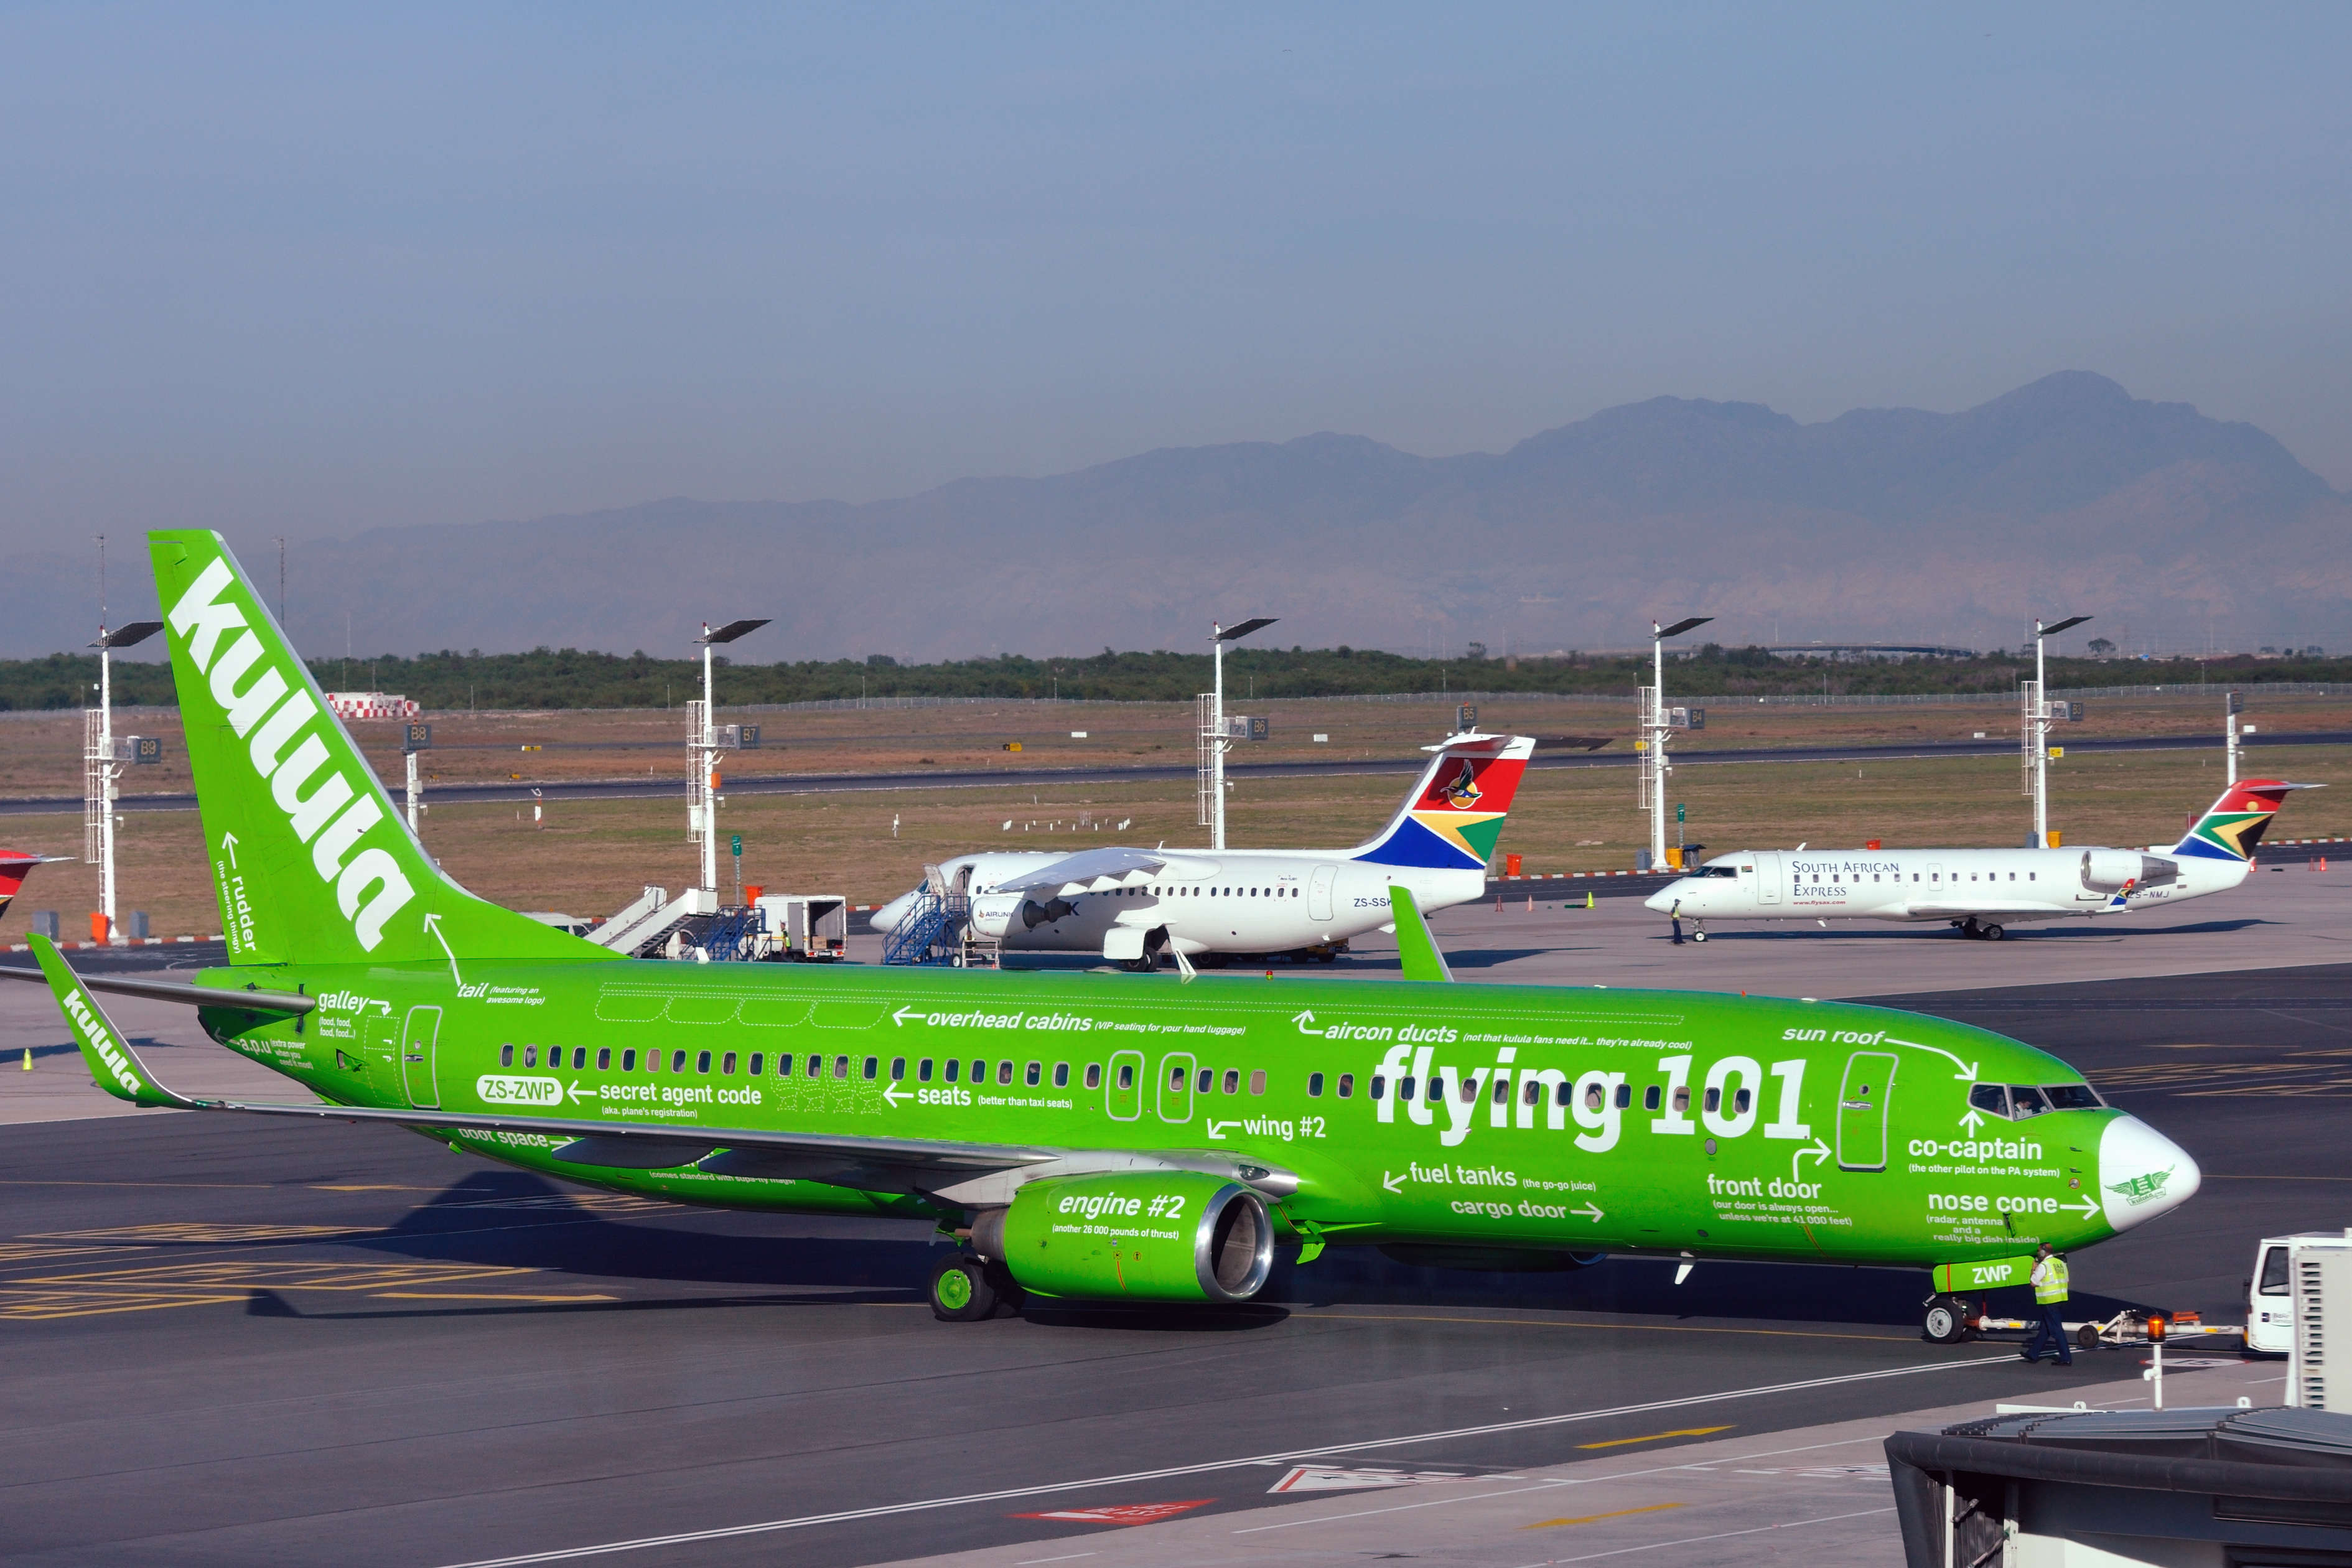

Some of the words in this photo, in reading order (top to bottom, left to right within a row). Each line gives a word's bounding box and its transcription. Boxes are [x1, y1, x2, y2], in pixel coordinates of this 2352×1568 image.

[411, 727, 426, 740] B8
[744, 728, 756, 741] B7
[1254, 720, 1265, 732] B6
[141, 740, 156, 755] B9
[167, 554, 417, 953] kulula
[1792, 861, 1837, 873] SOUTH
[1843, 861, 1900, 873] AFRICAN
[1794, 884, 1847, 897] EXPRESS
[217, 861, 225, 879] (the
[222, 881, 233, 920] steering
[230, 920, 243, 953] thingy)
[231, 876, 256, 953] rudder
[456, 981, 489, 997] tail
[490, 986, 528, 995] (featuring
[319, 991, 370, 1015] galley
[525, 996, 545, 1006] logo)
[319, 1017, 335, 1027] (food,
[337, 1018, 352, 1028] food,
[927, 1010, 1024, 1029] overhead
[1025, 1012, 1093, 1031] cabins
[1094, 1021, 1114, 1030] (VIP
[1114, 1023, 1146, 1033] seating
[1161, 1025, 1183, 1034] your
[1183, 1025, 1206, 1033] hand
[1207, 1025, 1246, 1035] luggage)
[62, 987, 142, 1096] kulula
[320, 1028, 335, 1038] food,
[1325, 1022, 1393, 1040] aircon
[1398, 1024, 1458, 1043] ducts
[1463, 1033, 1482, 1042] (not
[1483, 1034, 1501, 1042] that
[1503, 1034, 1532, 1043] kulula
[1533, 1035, 1553, 1043] fans
[1555, 1037, 1579, 1045] need
[1580, 1037, 1593, 1045] it...
[1597, 1037, 1630, 1047] they're
[1630, 1038, 1667, 1049] already
[1668, 1041, 1692, 1050] cool)
[1782, 1029, 1827, 1041] sun
[1832, 1031, 1885, 1045] roof
[239, 1038, 272, 1056] a.p.u
[483, 1080, 556, 1101] ZS-ZWP
[600, 1083, 657, 1101] secret
[662, 1085, 713, 1106] agent
[718, 1085, 762, 1105] code
[918, 1086, 971, 1106] seats
[978, 1095, 1006, 1106] (better
[1008, 1096, 1027, 1106] than
[1029, 1098, 1044, 1107] taxi
[1047, 1099, 1072, 1110] seats)
[1374, 1045, 1625, 1153] flying
[1650, 1055, 1811, 1140] 101
[602, 1106, 620, 1115] (aka.
[622, 1107, 650, 1116] plane's
[651, 1108, 697, 1119] registration)
[1244, 1119, 1293, 1141] wing
[1299, 1116, 1326, 1137] #2
[497, 1132, 548, 1147] space
[1909, 1137, 2042, 1164] co-captain
[1409, 1162, 1452, 1183] fuel
[1456, 1165, 1517, 1187] tanks
[1523, 1179, 1540, 1188] (the
[1542, 1182, 1569, 1191] go-go
[1570, 1181, 1596, 1192] juice)
[1909, 1164, 1925, 1173] (the
[1928, 1164, 1953, 1174] other
[1954, 1165, 1976, 1175] pilot
[1991, 1166, 2006, 1175] the
[2008, 1167, 2021, 1175] PA
[2023, 1168, 2060, 1178] system)
[1707, 1174, 1763, 1197] front
[1768, 1175, 1822, 1198] door
[1059, 1192, 1141, 1220] engine
[1147, 1195, 1185, 1218] #2
[1451, 1202, 1513, 1218] cargo
[1521, 1200, 1566, 1218] door
[1713, 1200, 1732, 1209] (our
[1734, 1201, 1756, 1210] door
[1758, 1202, 1768, 1210] is
[1768, 1203, 1803, 1213] always
[1804, 1206, 1838, 1214] open...
[1928, 1194, 1989, 1211] nose
[1996, 1197, 2058, 1213] cone
[1719, 1213, 1752, 1221] unless
[1807, 1216, 1827, 1225] 000
[1829, 1216, 1852, 1226] feet)
[1926, 1215, 1959, 1225] (radar,
[1962, 1217, 2004, 1226] antenna
[1052, 1223, 1081, 1233] (another
[1083, 1225, 1093, 1233] 26
[1094, 1226, 1109, 1234] 000
[1110, 1228, 1139, 1237] pounds
[1141, 1228, 1149, 1237] of
[1150, 1230, 1178, 1241] thrust)
[1934, 1233, 1964, 1243] really
[1964, 1234, 1981, 1244] big
[1972, 1264, 2012, 1284] ZWP
